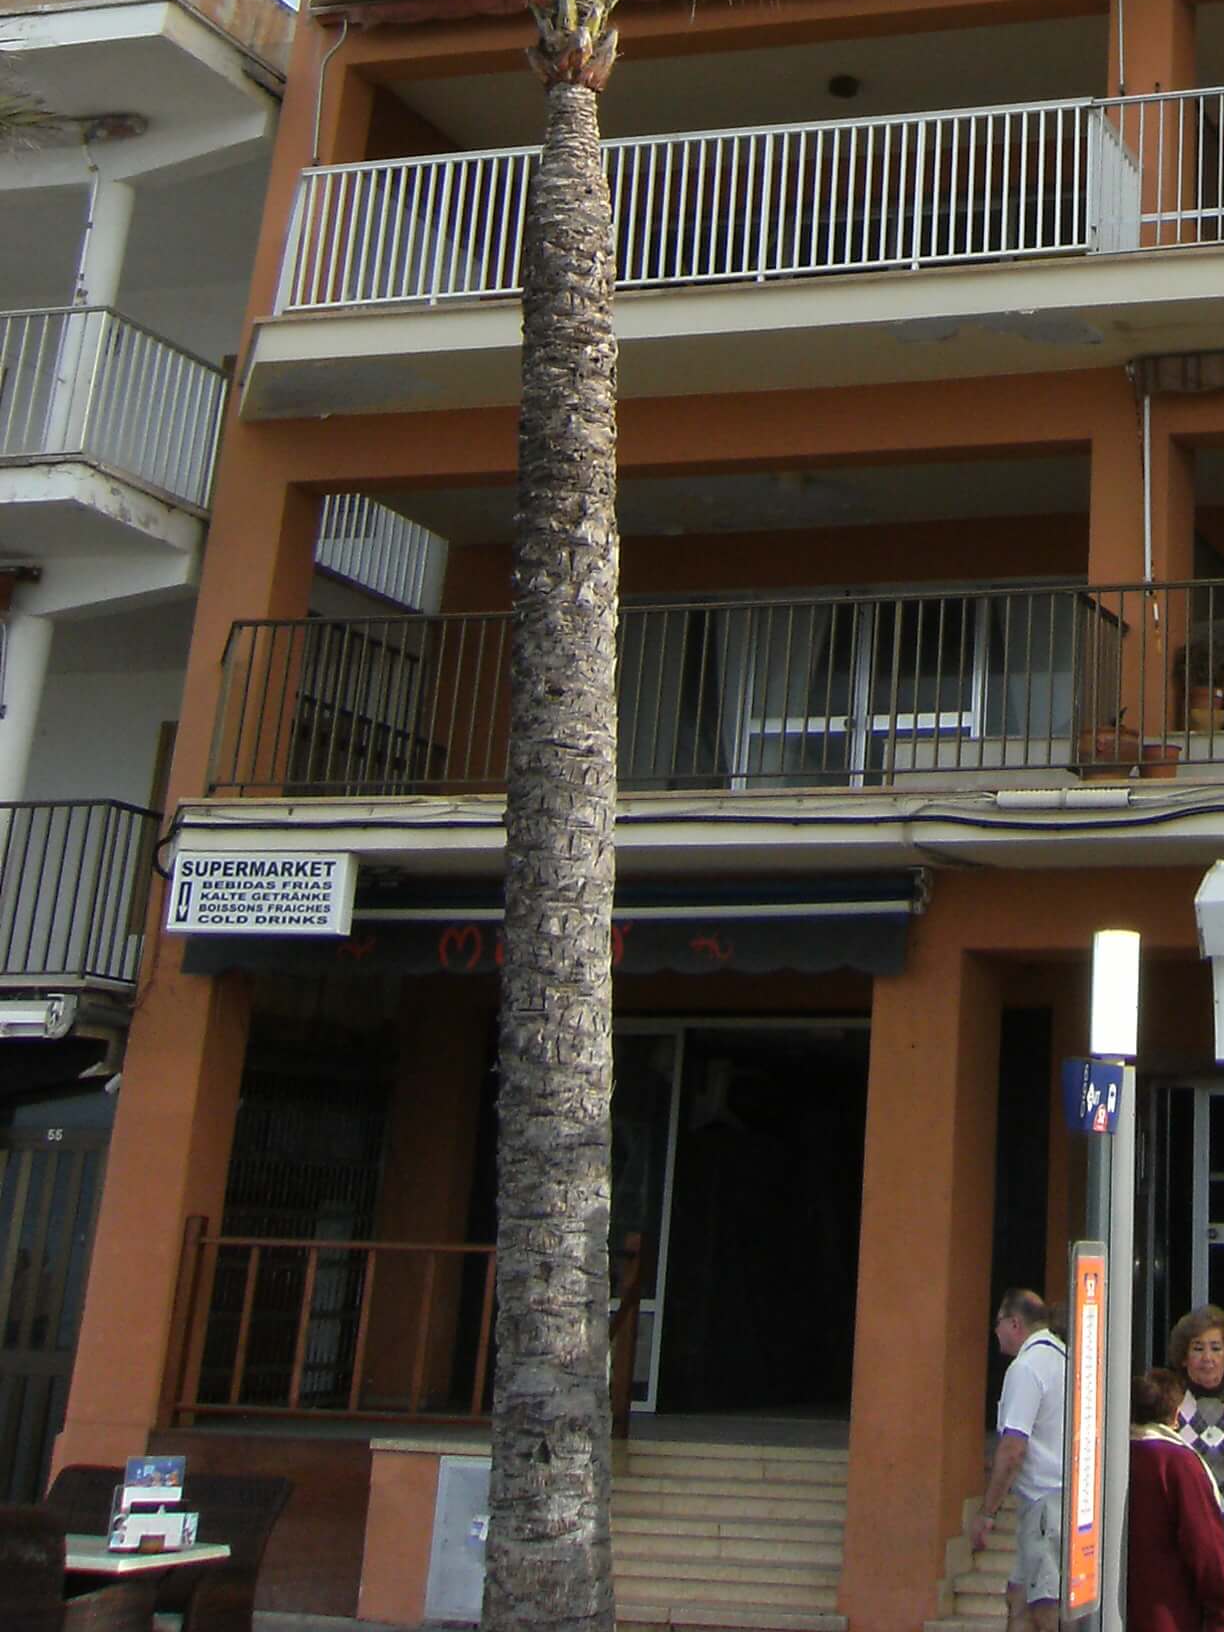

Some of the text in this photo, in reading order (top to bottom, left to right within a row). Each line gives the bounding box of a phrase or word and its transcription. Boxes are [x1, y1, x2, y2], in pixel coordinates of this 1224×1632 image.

[181, 860, 337, 878] SUPERMARKET
[202, 880, 333, 890] BEBIDAS FRIAS
[200, 892, 247, 901] KALTE
[199, 903, 332, 913] BOISSONS FRAICHES
[197, 915, 329, 925] COLD DRINKS
